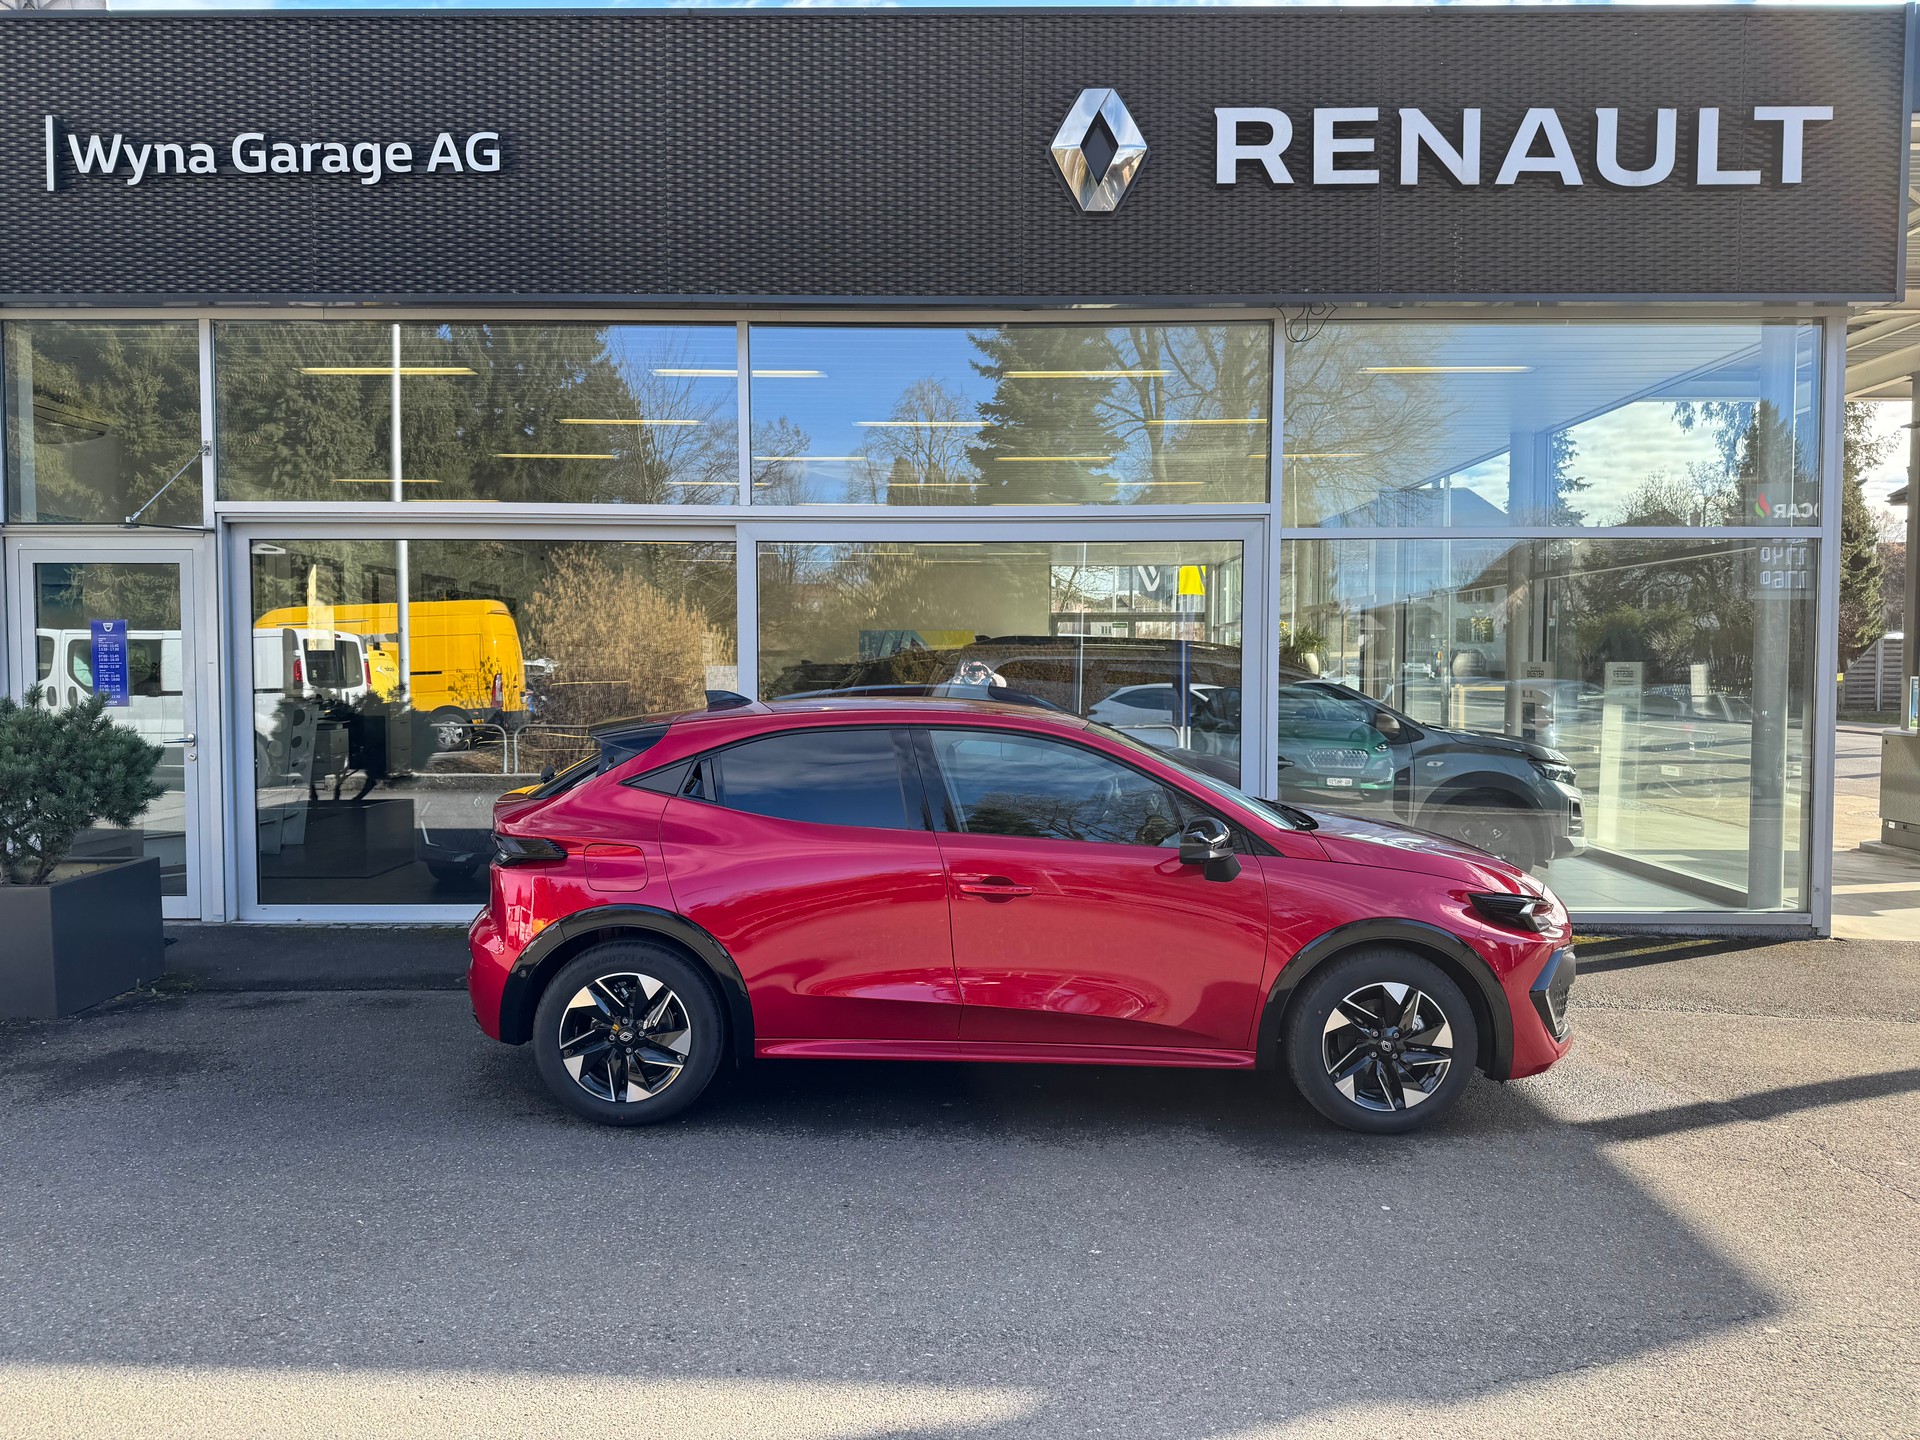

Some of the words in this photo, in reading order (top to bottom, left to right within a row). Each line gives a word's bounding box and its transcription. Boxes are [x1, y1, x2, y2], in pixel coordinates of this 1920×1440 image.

[67, 134, 217, 186] Wyna
[231, 133, 413, 185] Garage
[426, 132, 500, 172] AG
[1214, 105, 1834, 187] RENAULT
